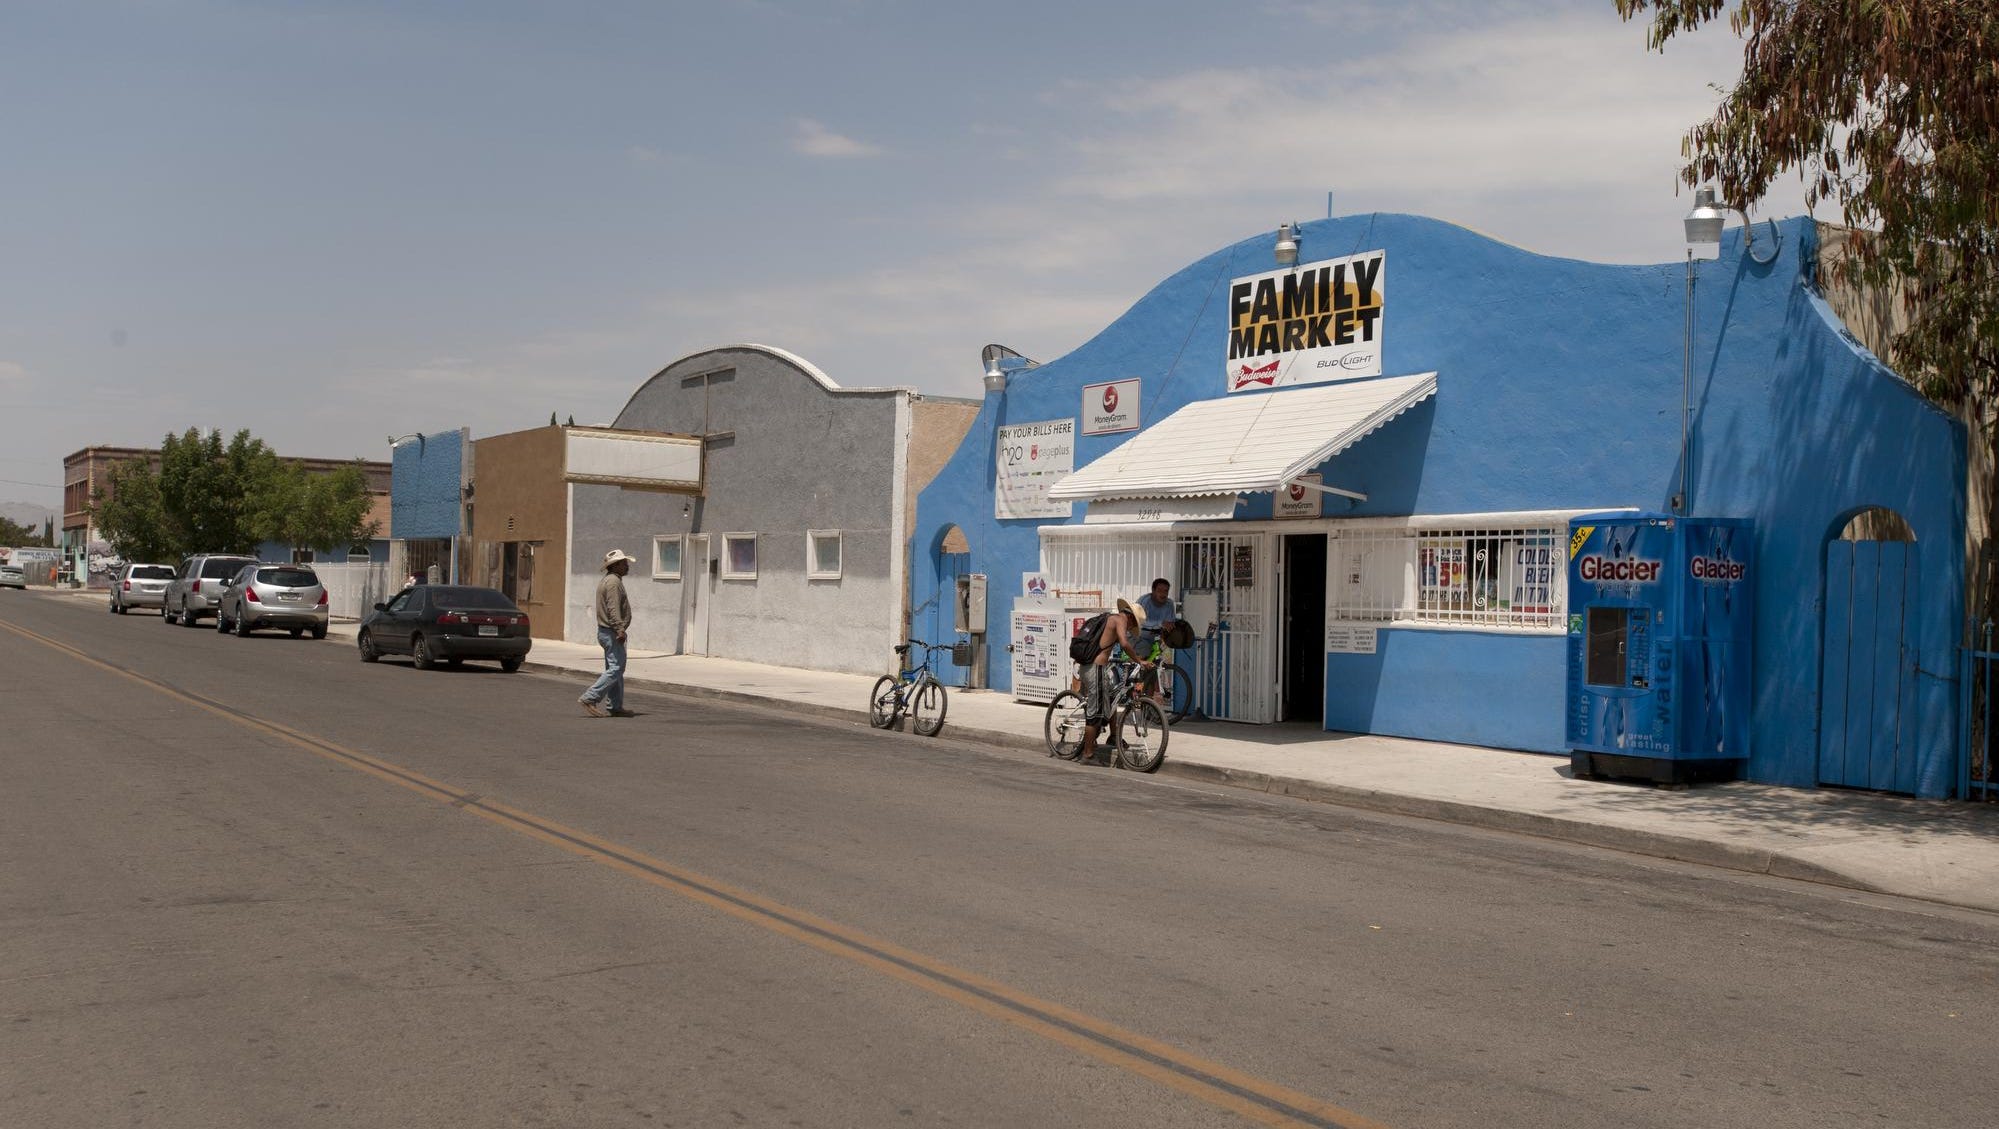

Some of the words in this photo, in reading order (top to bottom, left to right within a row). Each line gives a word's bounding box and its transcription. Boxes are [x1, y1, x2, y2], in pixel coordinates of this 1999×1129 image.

[1231, 257, 1382, 327] FAMILY
[1229, 307, 1381, 360] MARKET
[1316, 359, 1339, 369] BUD
[1343, 354, 1374, 365] LIGHT
[1235, 367, 1280, 384] Budweiser
[1095, 414, 1127, 424] MoneyGram
[1000, 430, 1012, 439] PAY
[1013, 428, 1032, 438] YOUR
[1033, 425, 1052, 436] BILLS
[1053, 423, 1072, 434] HERE
[1281, 501, 1313, 510] MoneyGram
[1581, 557, 1660, 581] Glacier
[1691, 557, 1745, 579] Glacier
[1515, 587, 1527, 603] IN
[1656, 643, 1672, 725] water
[1580, 695, 1590, 736] crisp
[1627, 733, 1653, 741] great
[1625, 740, 1670, 752] tasting
